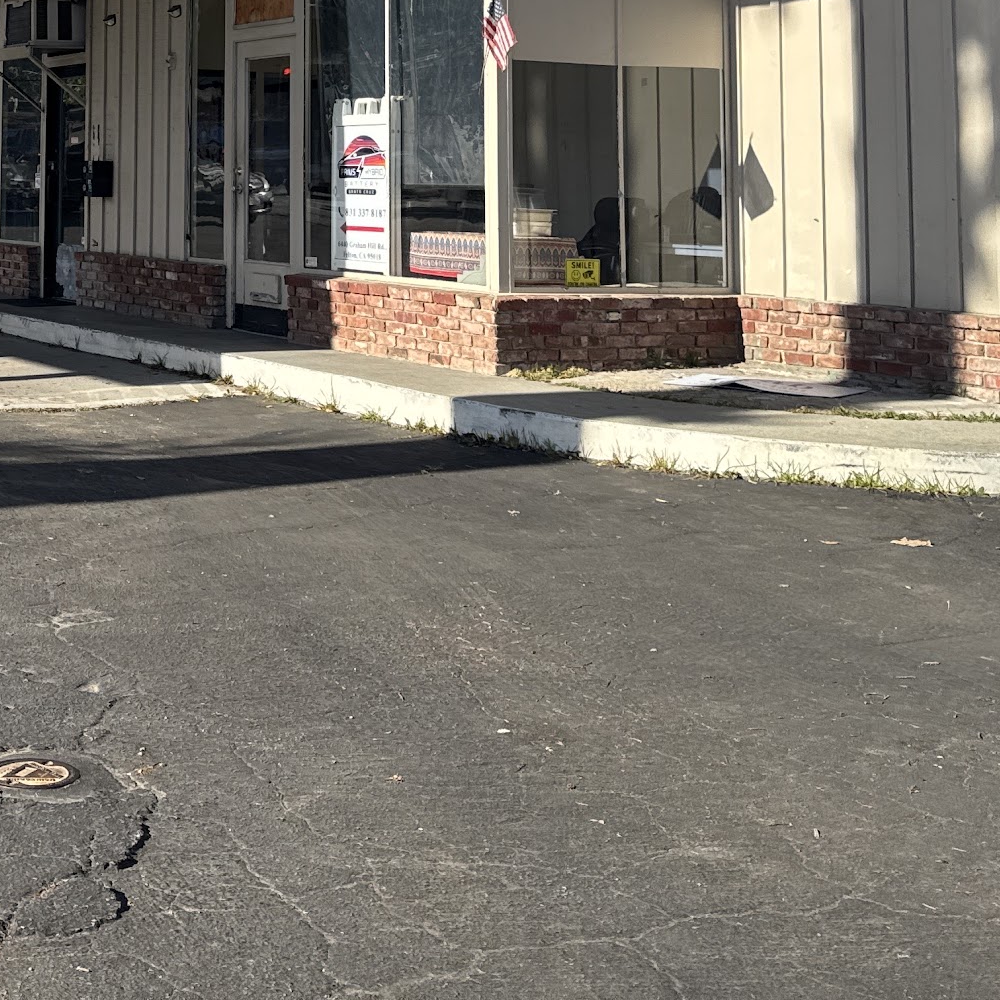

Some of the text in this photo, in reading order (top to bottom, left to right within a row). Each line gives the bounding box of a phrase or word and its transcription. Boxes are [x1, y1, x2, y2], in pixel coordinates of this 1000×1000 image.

[344, 208, 387, 218] 831 337 8187
[571, 261, 595, 269] SMILE!
